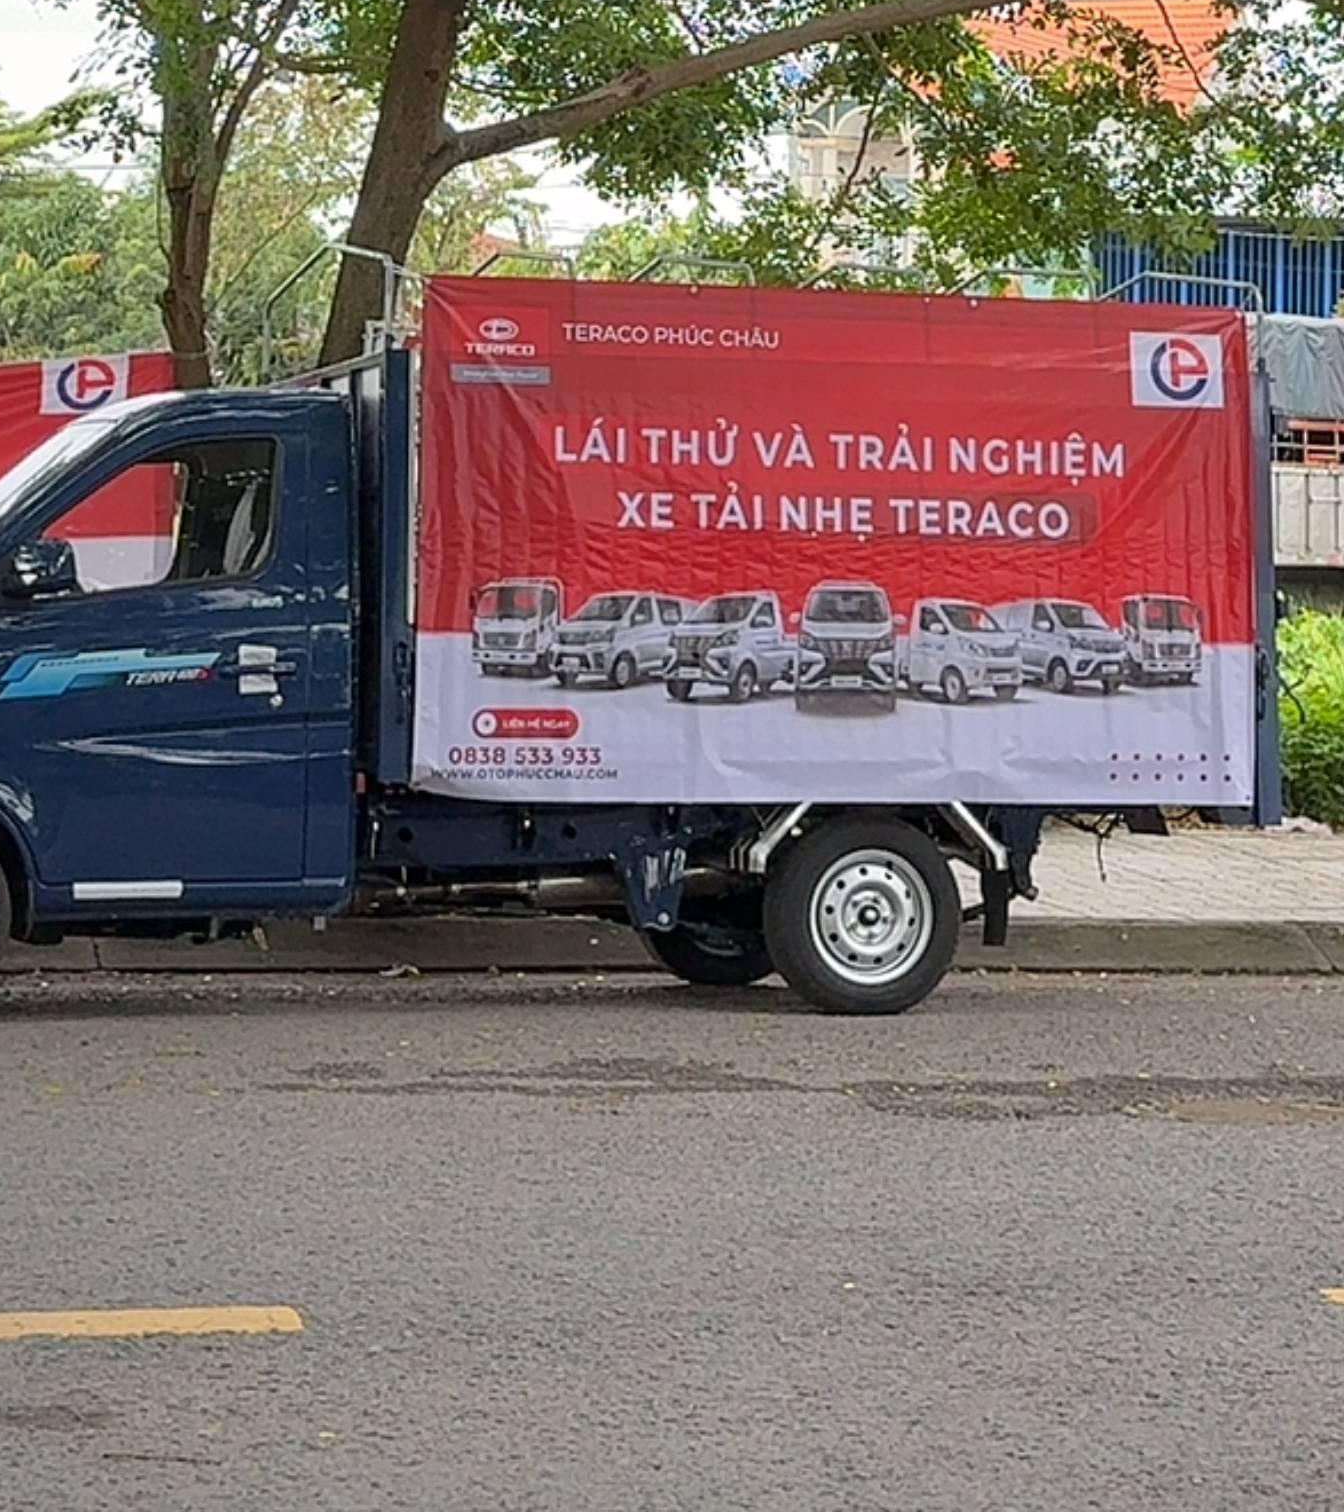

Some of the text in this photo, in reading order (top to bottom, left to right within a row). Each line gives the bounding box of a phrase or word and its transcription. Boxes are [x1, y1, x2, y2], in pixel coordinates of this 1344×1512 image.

[561, 322, 780, 350] TERACO PHÚC CHÂU
[554, 416, 1126, 486] LÁI THỬ VÀ TRẢI NGHIỆM
[616, 480, 1071, 543] XE TẢI NHẸ TERACO
[448, 746, 602, 766] 0838 533 933
